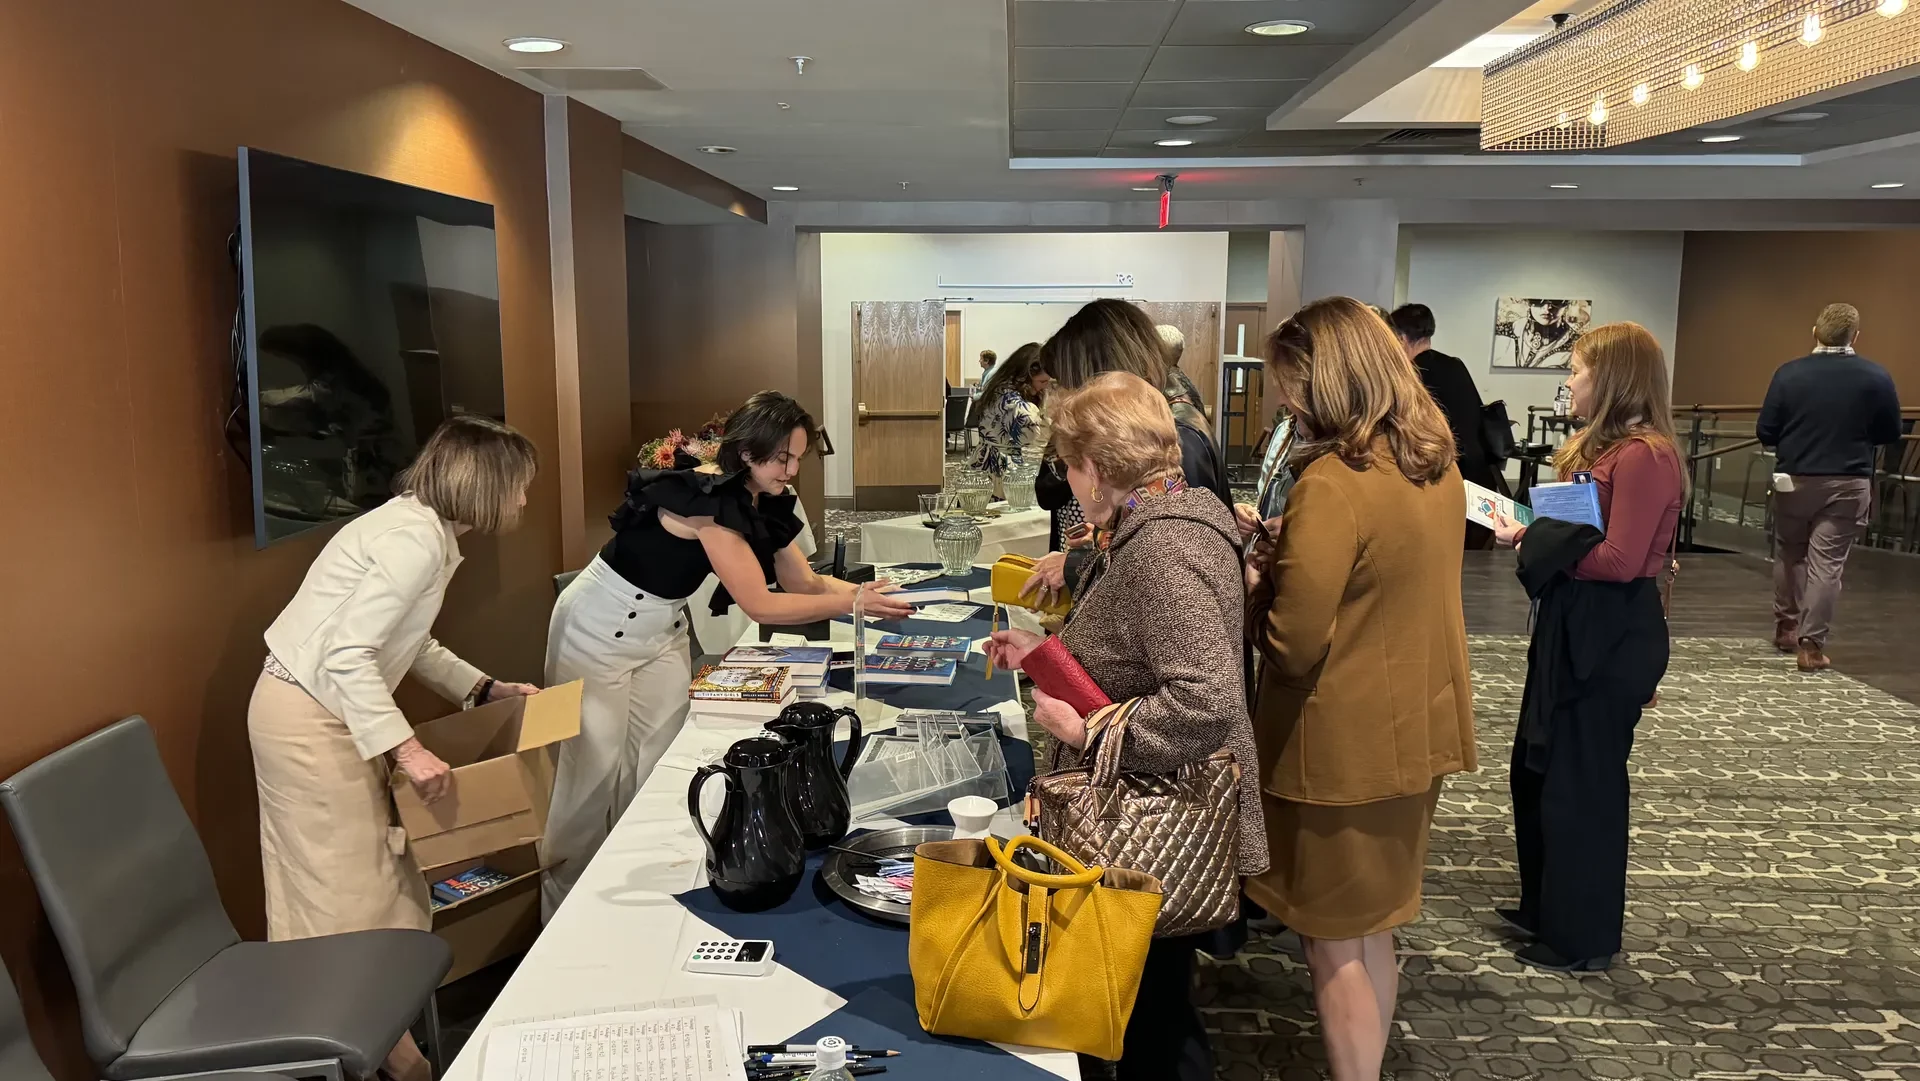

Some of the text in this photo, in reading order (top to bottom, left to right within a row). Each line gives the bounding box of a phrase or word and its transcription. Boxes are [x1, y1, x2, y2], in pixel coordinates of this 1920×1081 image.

[892, 656, 913, 671] STORY
[914, 658, 932, 671] LOST
[459, 873, 509, 895] STORY
